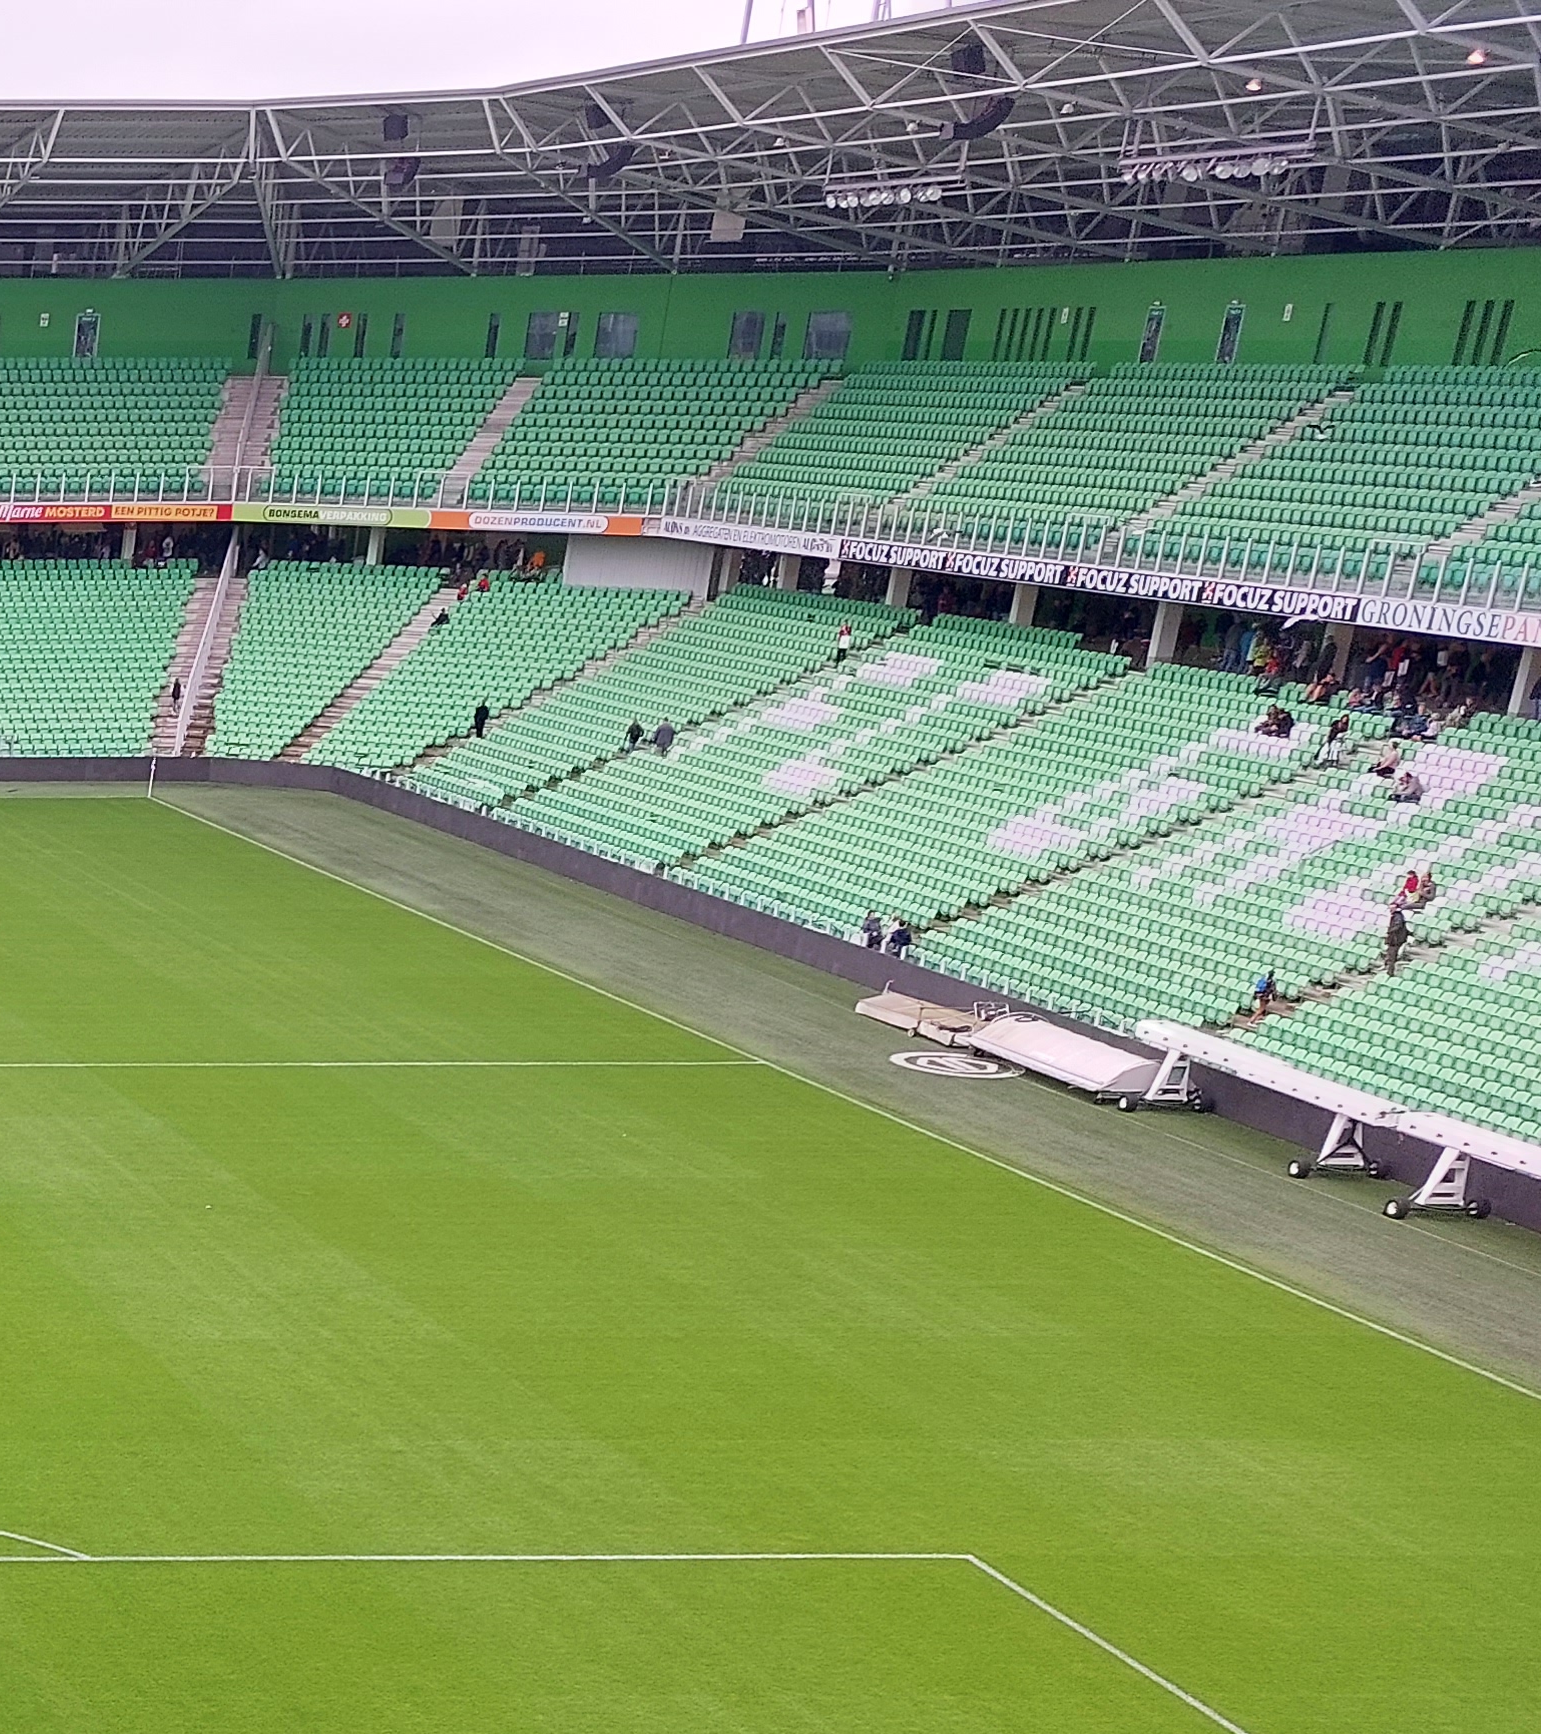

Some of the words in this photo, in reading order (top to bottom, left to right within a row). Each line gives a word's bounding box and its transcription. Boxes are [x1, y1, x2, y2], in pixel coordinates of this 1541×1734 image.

[45, 506, 105, 518] MOSTERD
[115, 506, 134, 516] EEN
[137, 506, 174, 517] PITTIG
[177, 507, 215, 517] POTJE?
[474, 515, 602, 529] DOZENPRODUCENT.NL
[849, 543, 889, 564] FOCUZ
[889, 547, 945, 570] SUPPORT
[954, 554, 1000, 577] FOCUZ
[1000, 561, 1065, 585] SUPPORT
[1077, 569, 1129, 592] FOCUZ
[1129, 575, 1203, 600] SUPPORT
[1215, 583, 1273, 611] FOCUZ
[1271, 590, 1358, 621] SUPPORT
